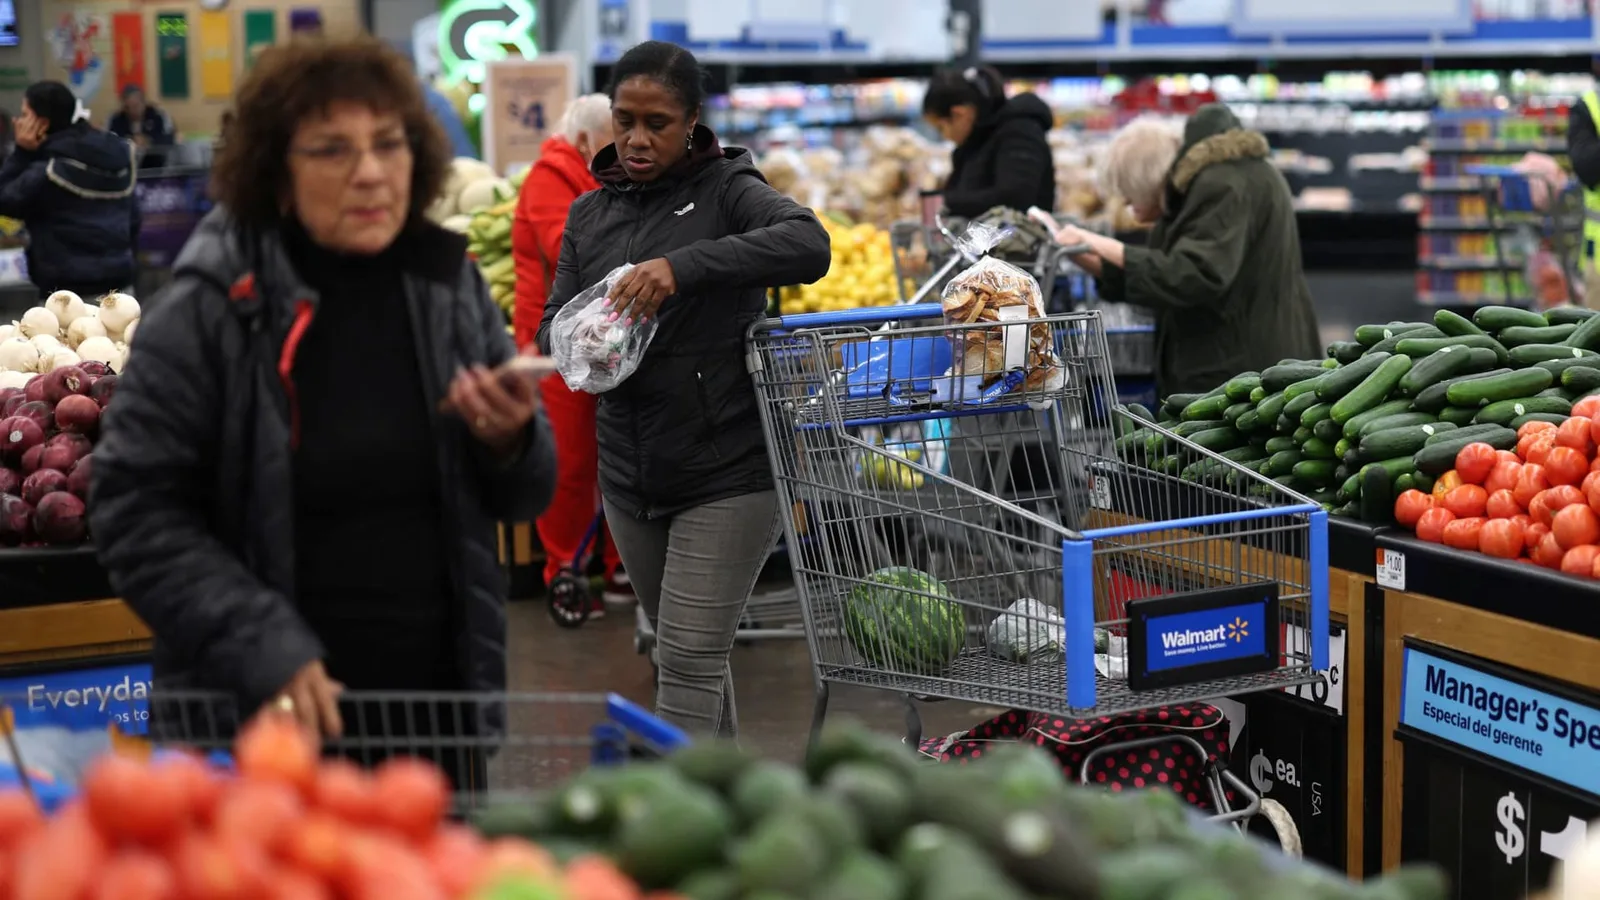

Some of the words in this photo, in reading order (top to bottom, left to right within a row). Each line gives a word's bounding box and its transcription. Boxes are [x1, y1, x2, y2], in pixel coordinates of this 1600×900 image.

[1161, 624, 1226, 649] Walmart
[1423, 701, 1471, 731] Especial
[1472, 719, 1491, 738] del
[1493, 728, 1544, 757] gerente
[1311, 781, 1322, 817] USA
